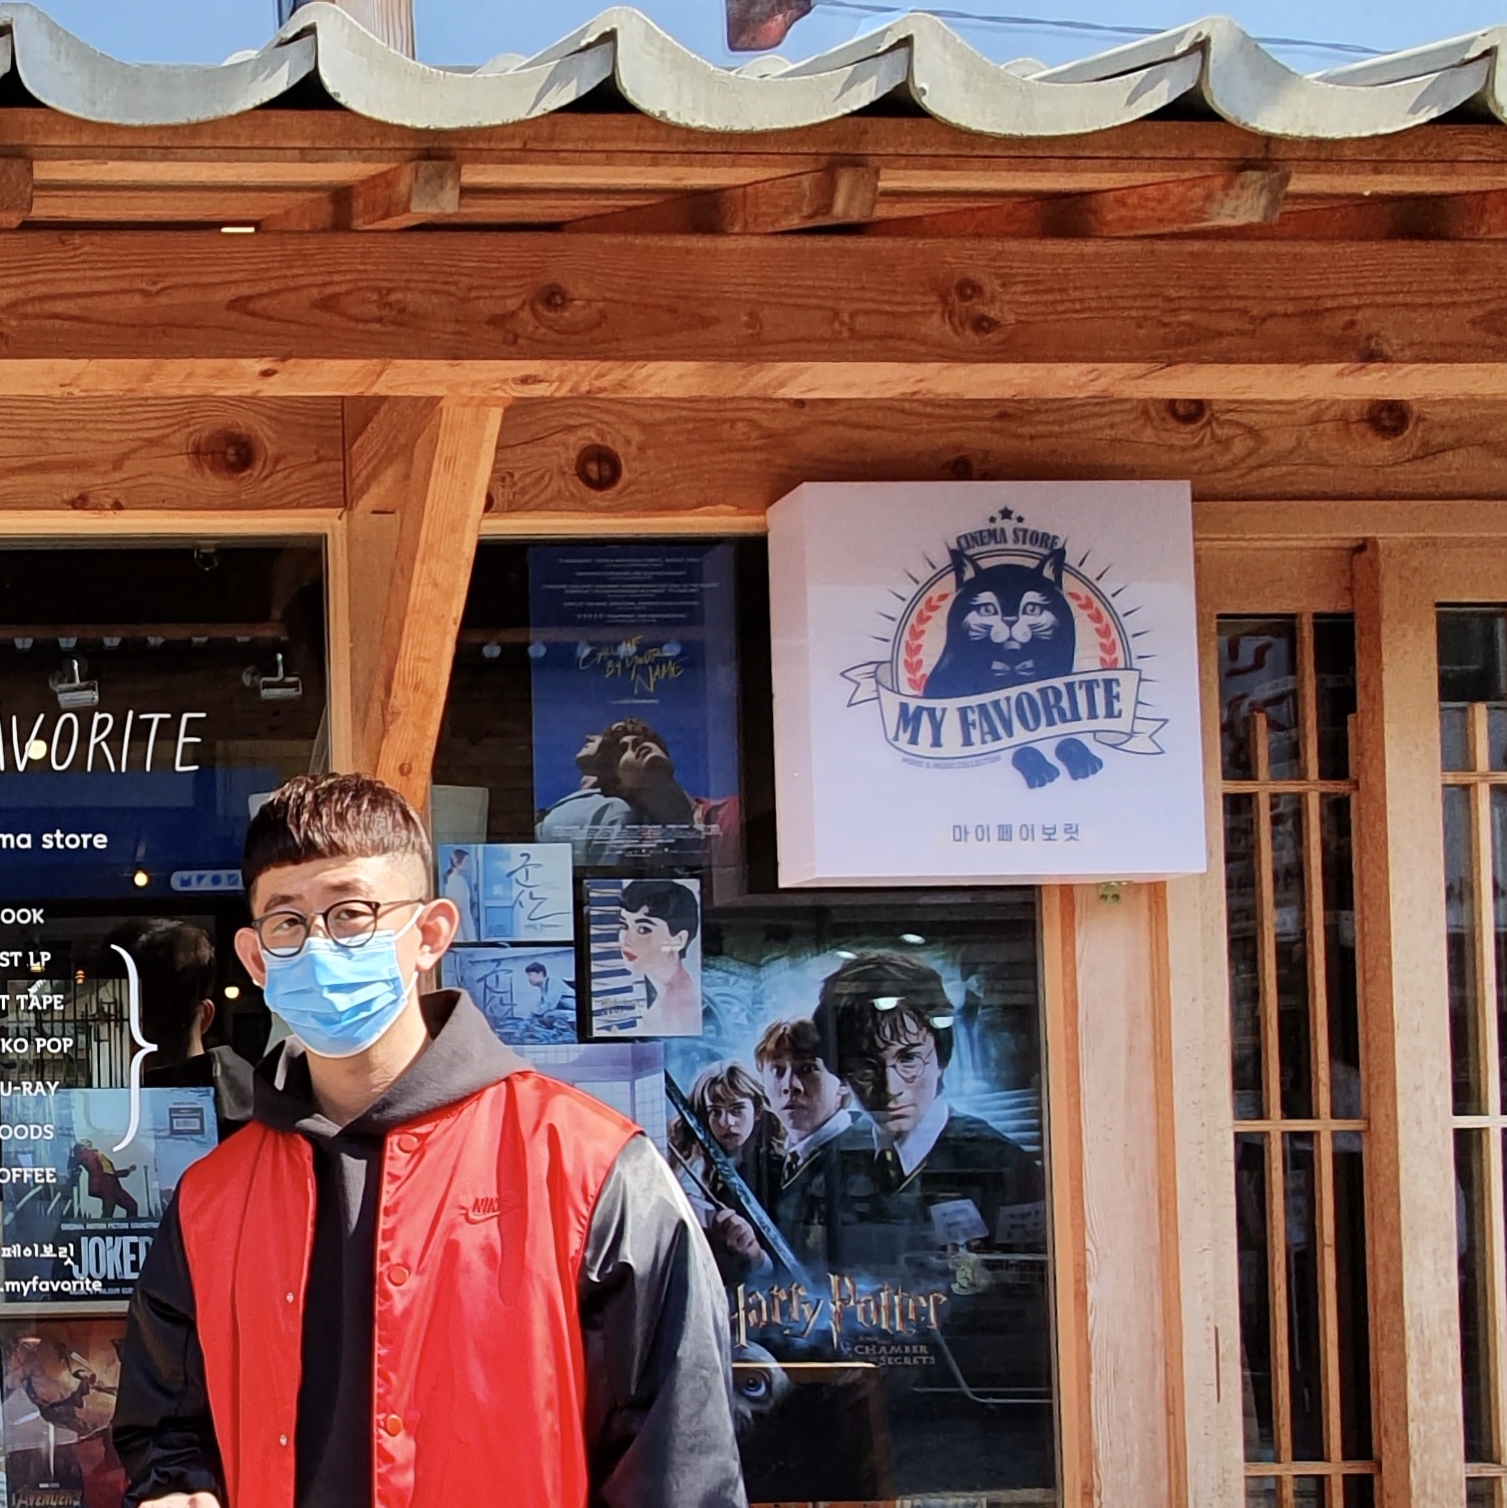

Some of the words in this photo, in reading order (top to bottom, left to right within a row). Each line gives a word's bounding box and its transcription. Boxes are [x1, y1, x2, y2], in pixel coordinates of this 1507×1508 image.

[956, 527, 1008, 551] CINEMA
[1013, 527, 1060, 551] STORE
[892, 702, 947, 748] MY
[956, 678, 1123, 747] FAVORITE
[41, 829, 108, 850] store
[952, 822, 1080, 843] 마이페이보릿
[28, 951, 51, 967] LP
[16, 994, 64, 1011] TAPE
[35, 1037, 74, 1054] POP
[827, 1272, 948, 1350] Potter
[854, 1344, 929, 1355] CHAMBER
[878, 1355, 936, 1366] SECRETS
